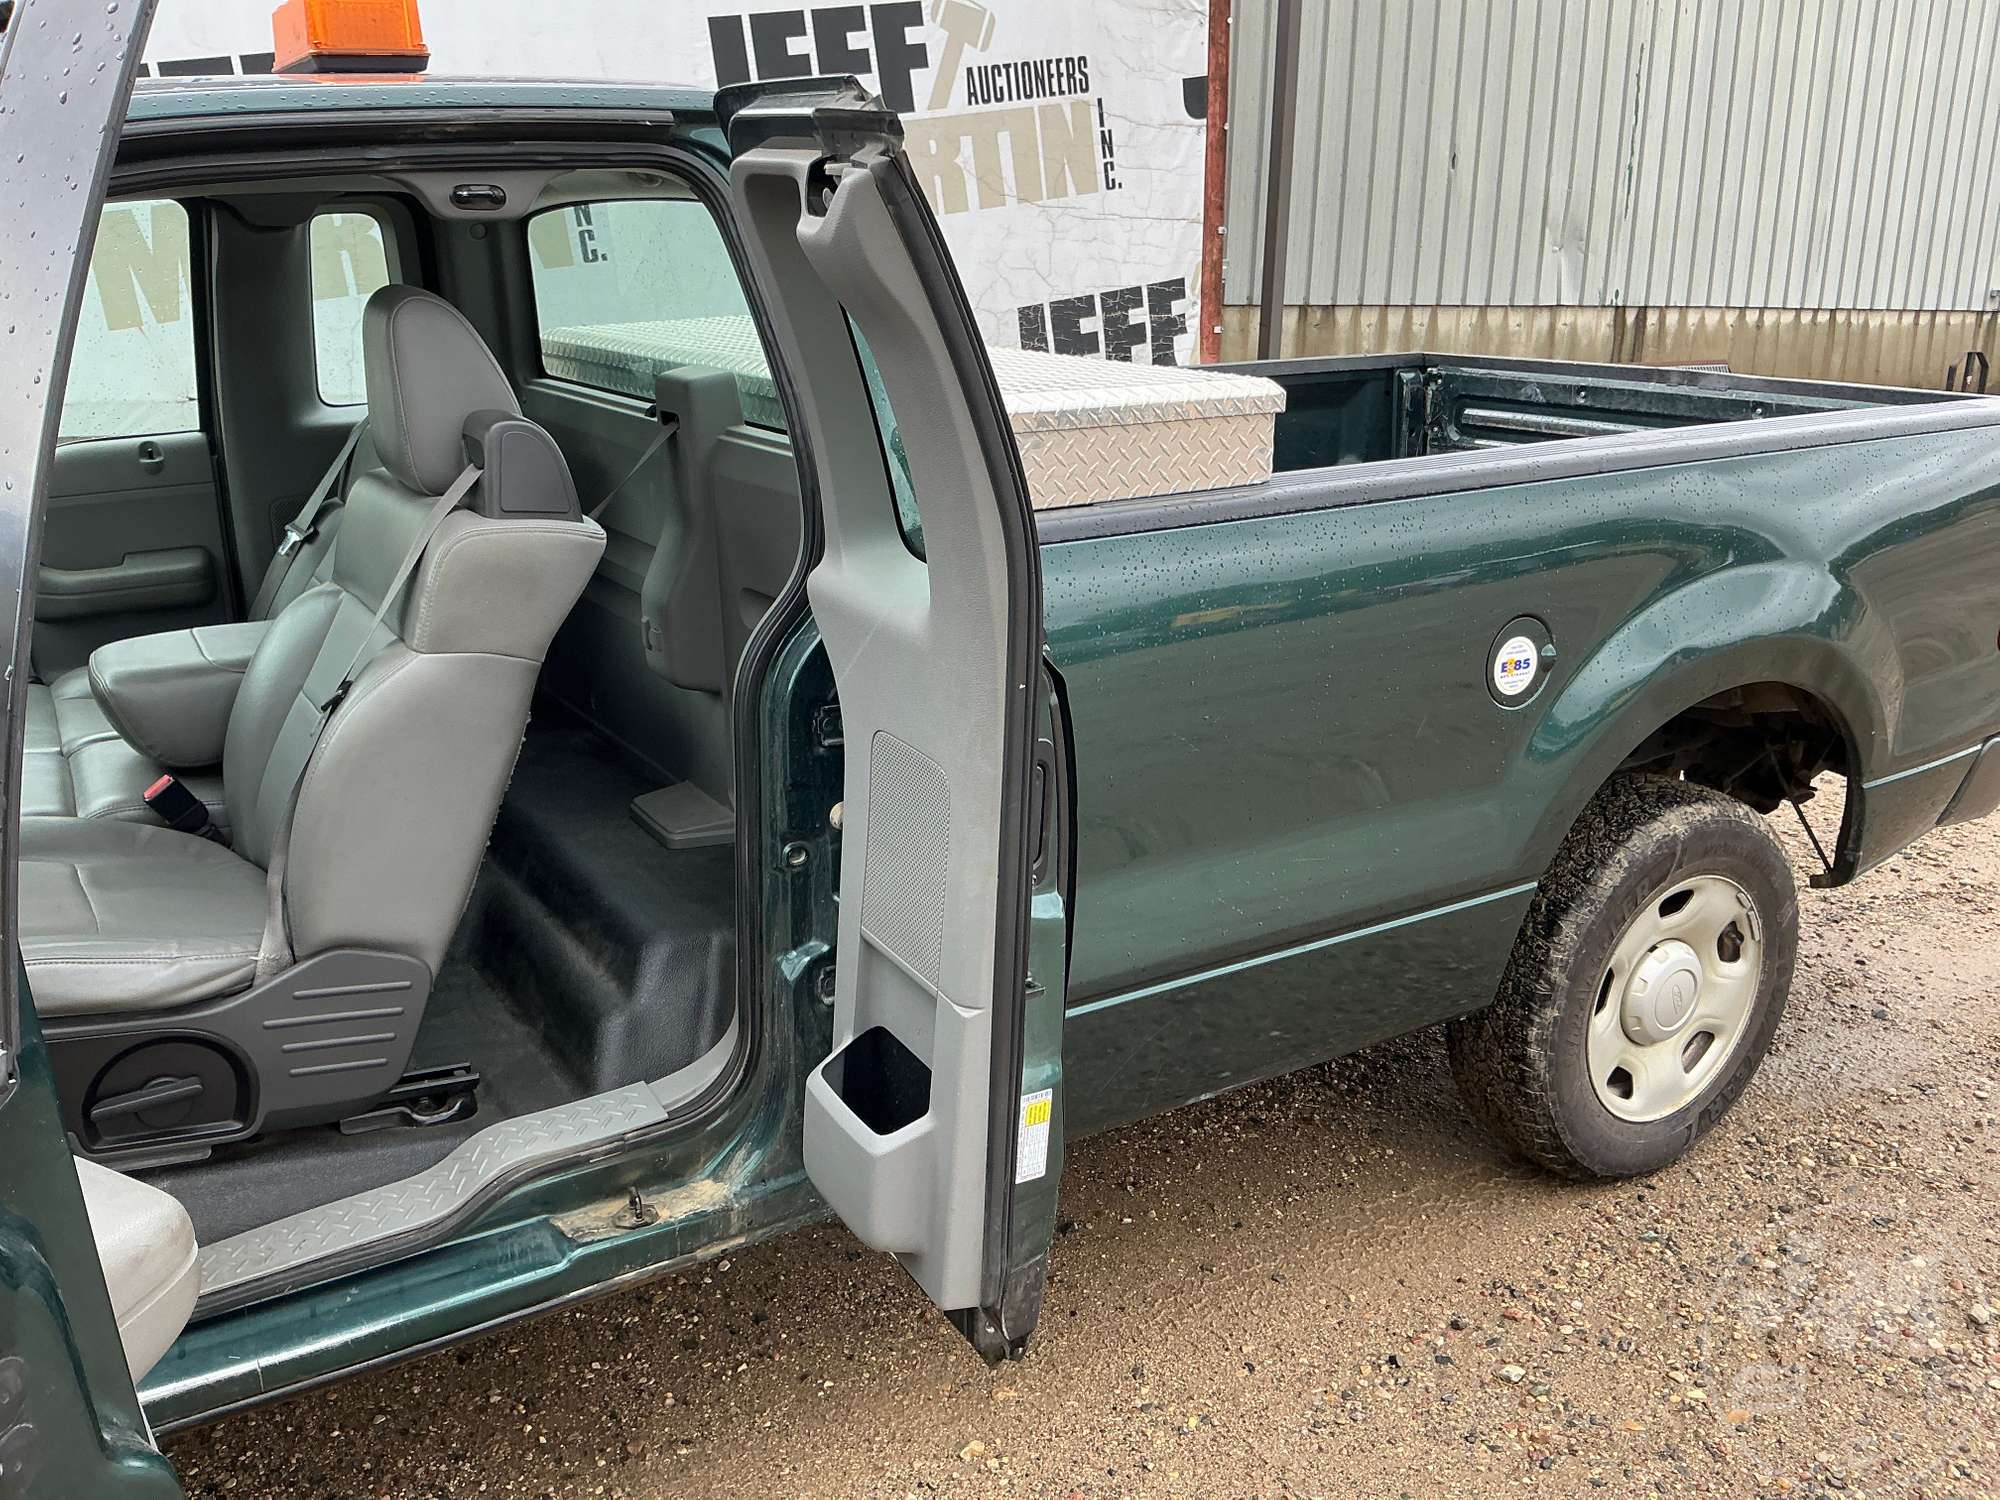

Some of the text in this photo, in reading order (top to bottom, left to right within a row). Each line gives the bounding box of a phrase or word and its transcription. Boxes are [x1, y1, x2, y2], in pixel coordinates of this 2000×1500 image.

[966, 56, 1090, 106] AUCTIONEERS
[902, 101, 1099, 216] RTIN
[1097, 97, 1122, 191] INC.
[574, 204, 608, 263] NC.
